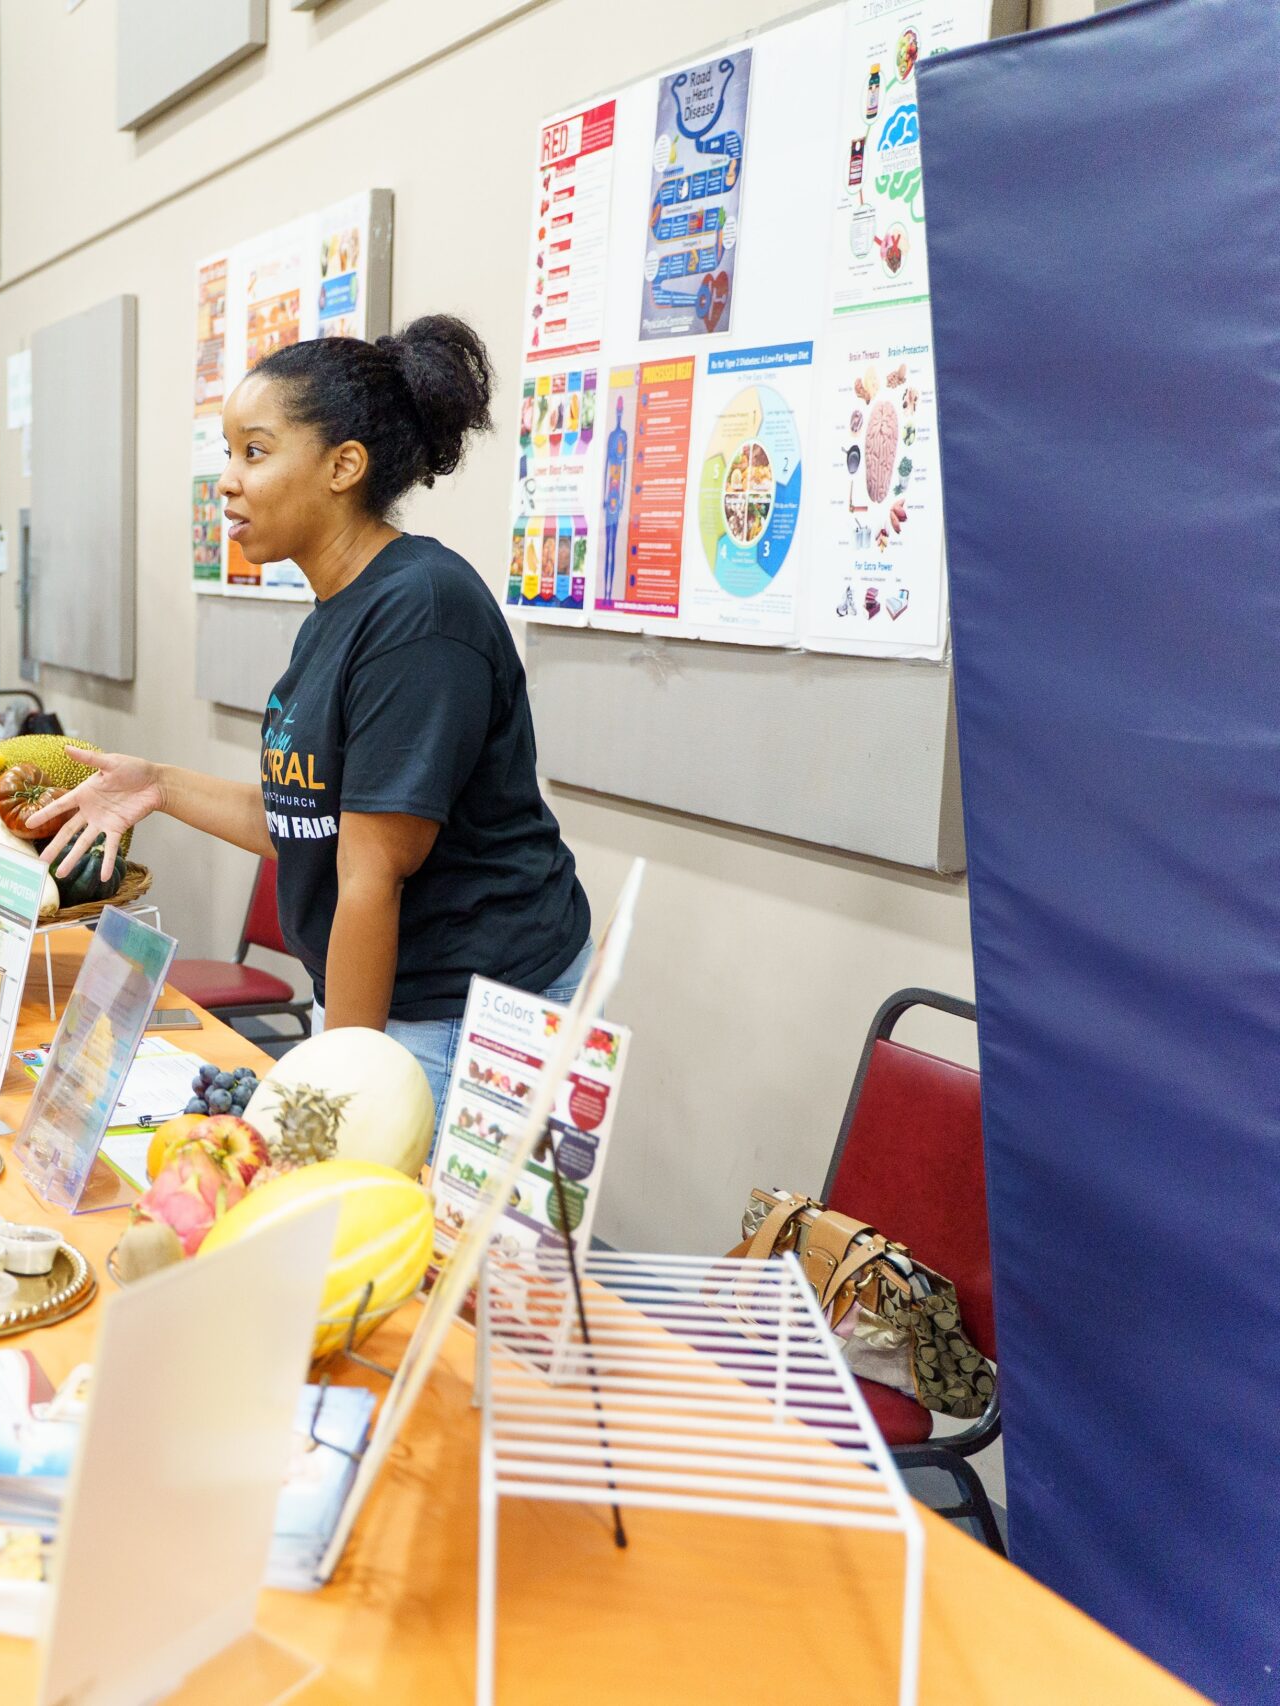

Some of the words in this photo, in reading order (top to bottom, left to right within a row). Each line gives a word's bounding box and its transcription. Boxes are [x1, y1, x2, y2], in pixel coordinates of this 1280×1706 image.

[689, 66, 712, 87] Road
[691, 86, 714, 101] Heart
[684, 102, 715, 121] Disease
[543, 124, 568, 161] RED
[783, 457, 789, 472] 2
[720, 544, 727, 559] 4
[763, 541, 770, 557] 3
[291, 815, 338, 840] FAIR
[494, 995, 536, 1024] Colors
